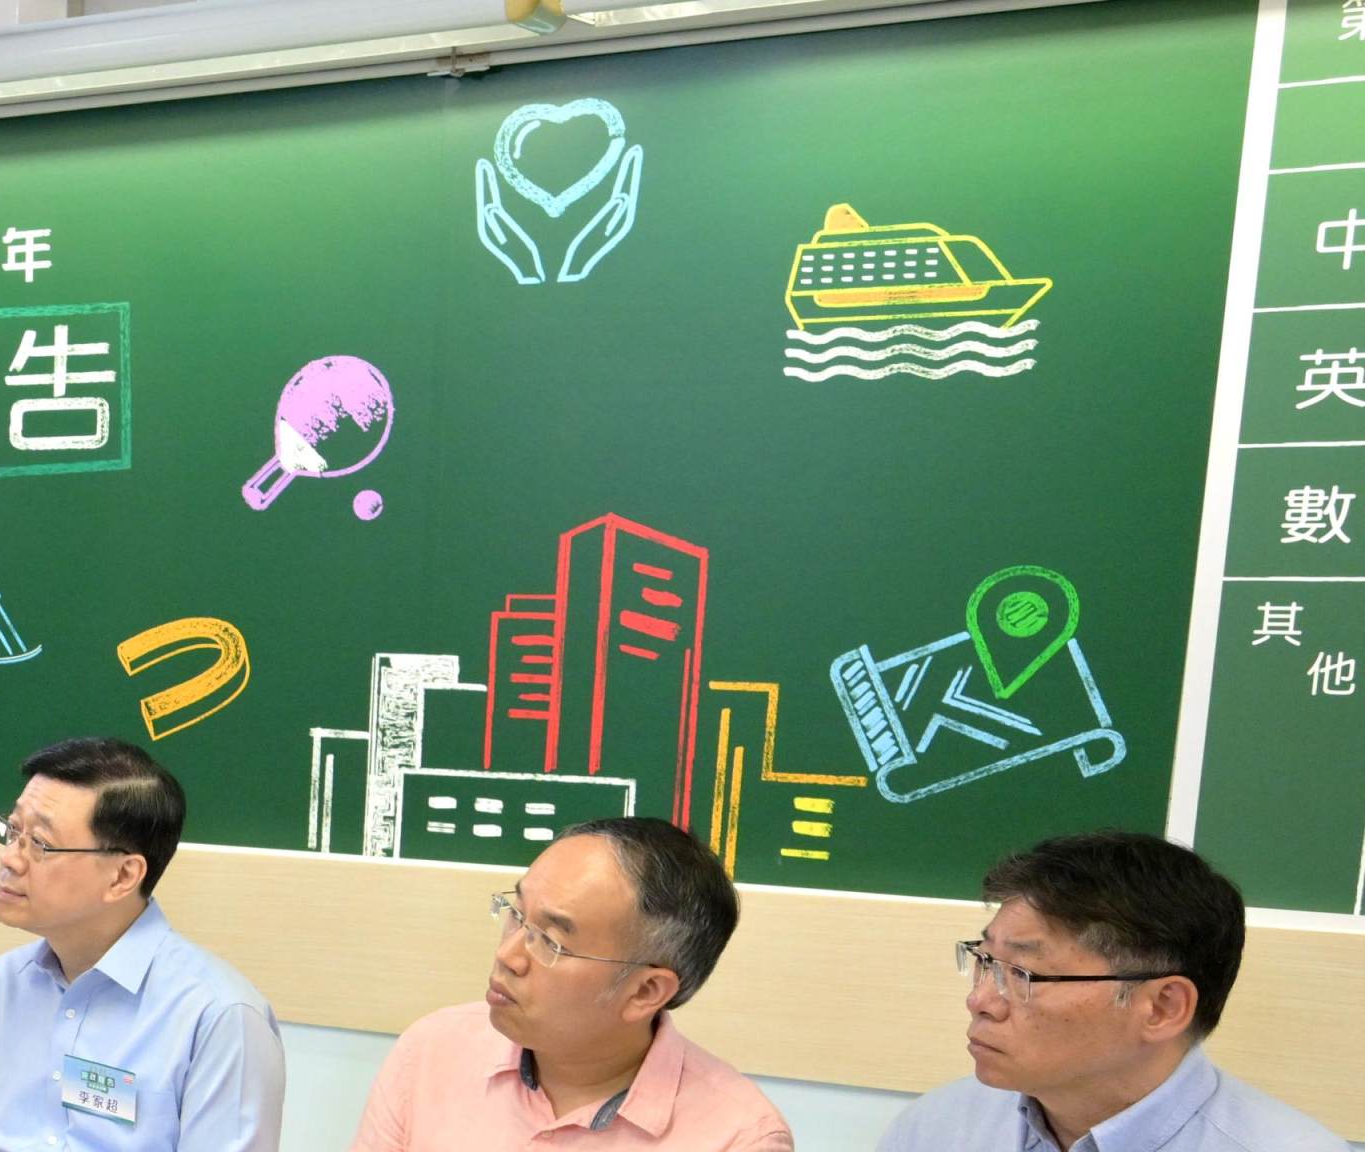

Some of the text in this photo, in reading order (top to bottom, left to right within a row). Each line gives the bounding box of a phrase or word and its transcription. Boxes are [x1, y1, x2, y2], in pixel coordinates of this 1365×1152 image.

[1316, 208, 1365, 270] 中
[1295, 347, 1365, 410] 英
[1280, 485, 1356, 544] 數
[78, 1090, 118, 1113] 李家超
